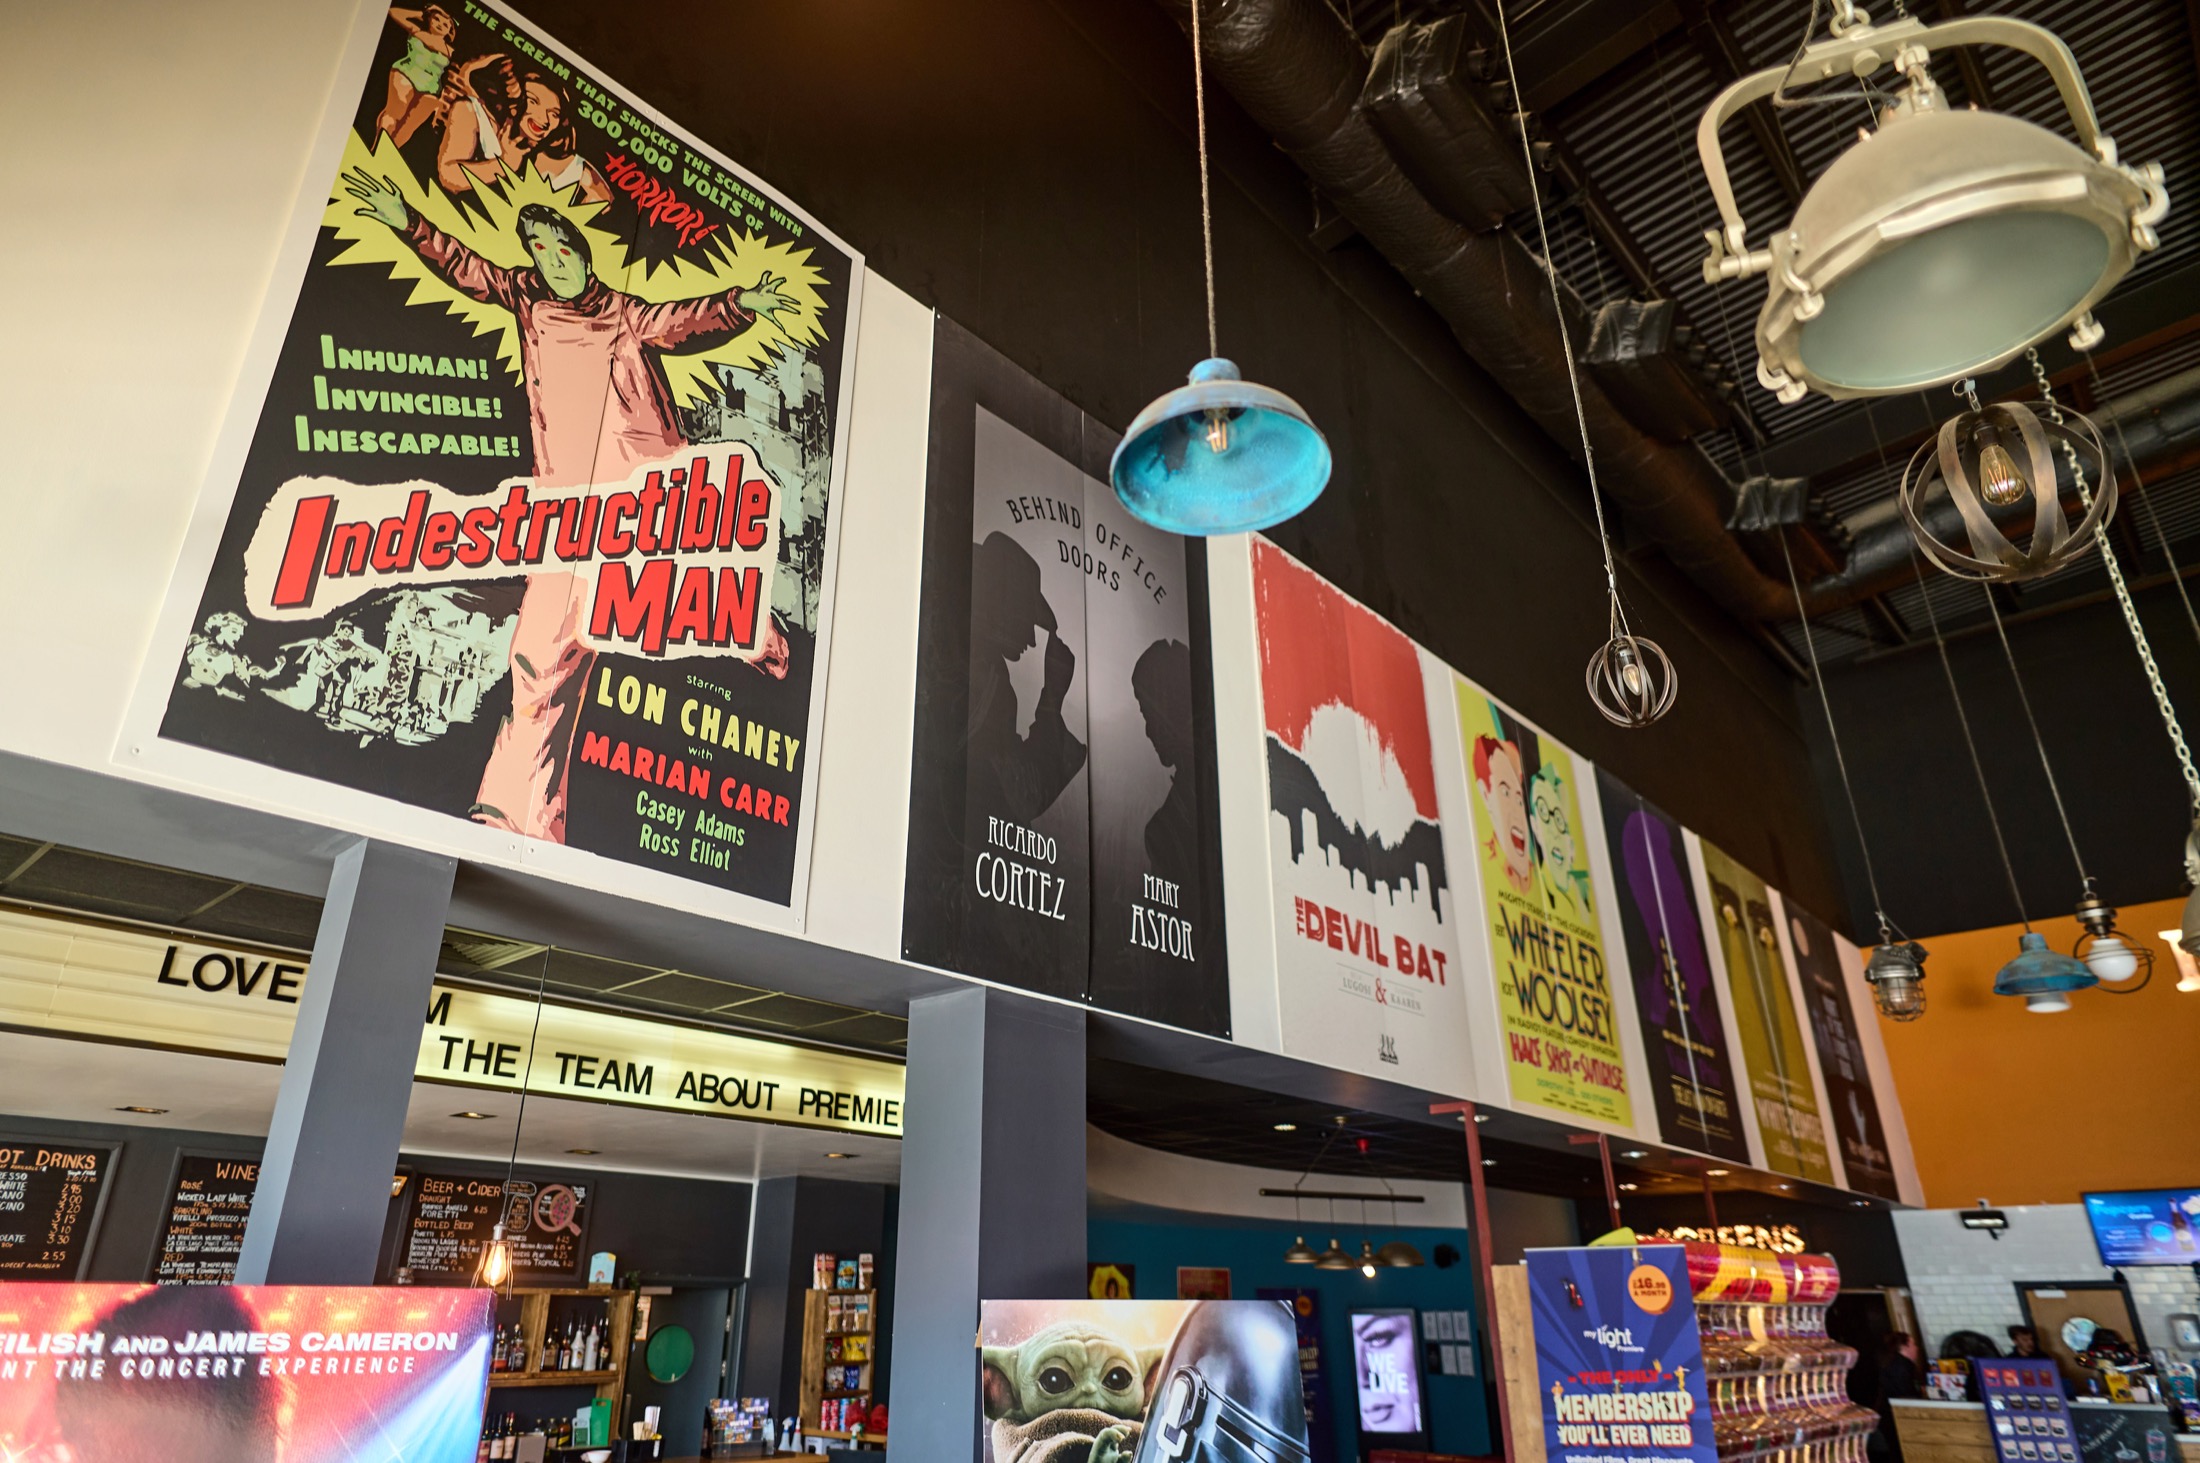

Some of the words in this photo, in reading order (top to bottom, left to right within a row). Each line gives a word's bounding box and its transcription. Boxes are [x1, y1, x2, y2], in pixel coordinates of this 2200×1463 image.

[463, 1, 499, 29] THE
[502, 28, 570, 81] SCREAM
[575, 76, 617, 111] THAT
[620, 107, 679, 155] SHOCKS
[684, 150, 711, 175] THE
[715, 168, 765, 212] SCREEN
[769, 206, 802, 237] WITH
[577, 100, 674, 174] 300,000
[682, 169, 742, 217] VOLTS
[745, 213, 764, 232] OF
[604, 152, 717, 248] HORROR!
[321, 334, 489, 381] INHUMAN!
[314, 375, 503, 419] INVINCIBLE!
[295, 415, 521, 458] INESCAPABLE!
[1006, 496, 1081, 530] BEHIND
[1096, 523, 1167, 605] OFFICE
[1057, 539, 1120, 592] DOORS
[589, 560, 762, 657] MAN
[687, 674, 732, 701] starring
[597, 666, 667, 725] LON
[680, 698, 800, 773] CHANEY
[688, 745, 713, 761] with
[580, 731, 711, 800] MARIAN
[720, 777, 791, 827] CARR
[636, 790, 686, 831] Casey
[695, 809, 745, 847] Adams
[988, 815, 1057, 865] RICARDO
[639, 823, 680, 857] Ross
[690, 838, 731, 871] Elliot
[975, 851, 1066, 921] CORTEZ
[1143, 873, 1179, 909] MARY
[1130, 904, 1195, 962] ASTOR
[1294, 895, 1305, 936] THE
[1304, 899, 1389, 968] DEVIL
[1394, 934, 1447, 986] BAT
[1498, 902, 1608, 998] WHEELER
[157, 945, 305, 1004] LOVE
[425, 992, 452, 1027] M
[1343, 977, 1371, 995] LUGOSI
[1375, 977, 1388, 1005] &
[1508, 960, 1615, 1046] WOOLSEY
[439, 1035, 521, 1078] THE
[555, 1052, 654, 1096] TEAM
[676, 1071, 780, 1111] ABOUT
[798, 1088, 901, 1127] PREMIE
[0, 1148, 25, 1166] OT
[35, 1149, 97, 1170] DRINKS
[424, 1178, 455, 1194] BEER
[467, 1181, 501, 1197] CIDER
[414, 1218, 450, 1229] BOTTLED
[454, 1220, 474, 1230] BEER
[421, 1210, 459, 1219] PORETTI
[164, 1253, 184, 1262] RED
[112, 1337, 168, 1355] AND
[174, 1331, 290, 1354] JAMES
[301, 1331, 458, 1352] CAMERON
[1597, 1324, 1633, 1348] light
[1, 1359, 37, 1379] NT
[54, 1358, 106, 1380] THE
[120, 1357, 246, 1380] CONCERT
[259, 1356, 415, 1377] EXPERIENCE
[1366, 1352, 1396, 1373] WE
[1368, 1372, 1409, 1394] LIVE
[1578, 1371, 1613, 1384] THE
[1615, 1369, 1660, 1384] ONLY
[1554, 1391, 1695, 1423] MEMBERSHIP
[1557, 1424, 1610, 1446] YOU'LL
[1611, 1424, 1650, 1447] EVER
[1651, 1424, 1694, 1447] NEED
